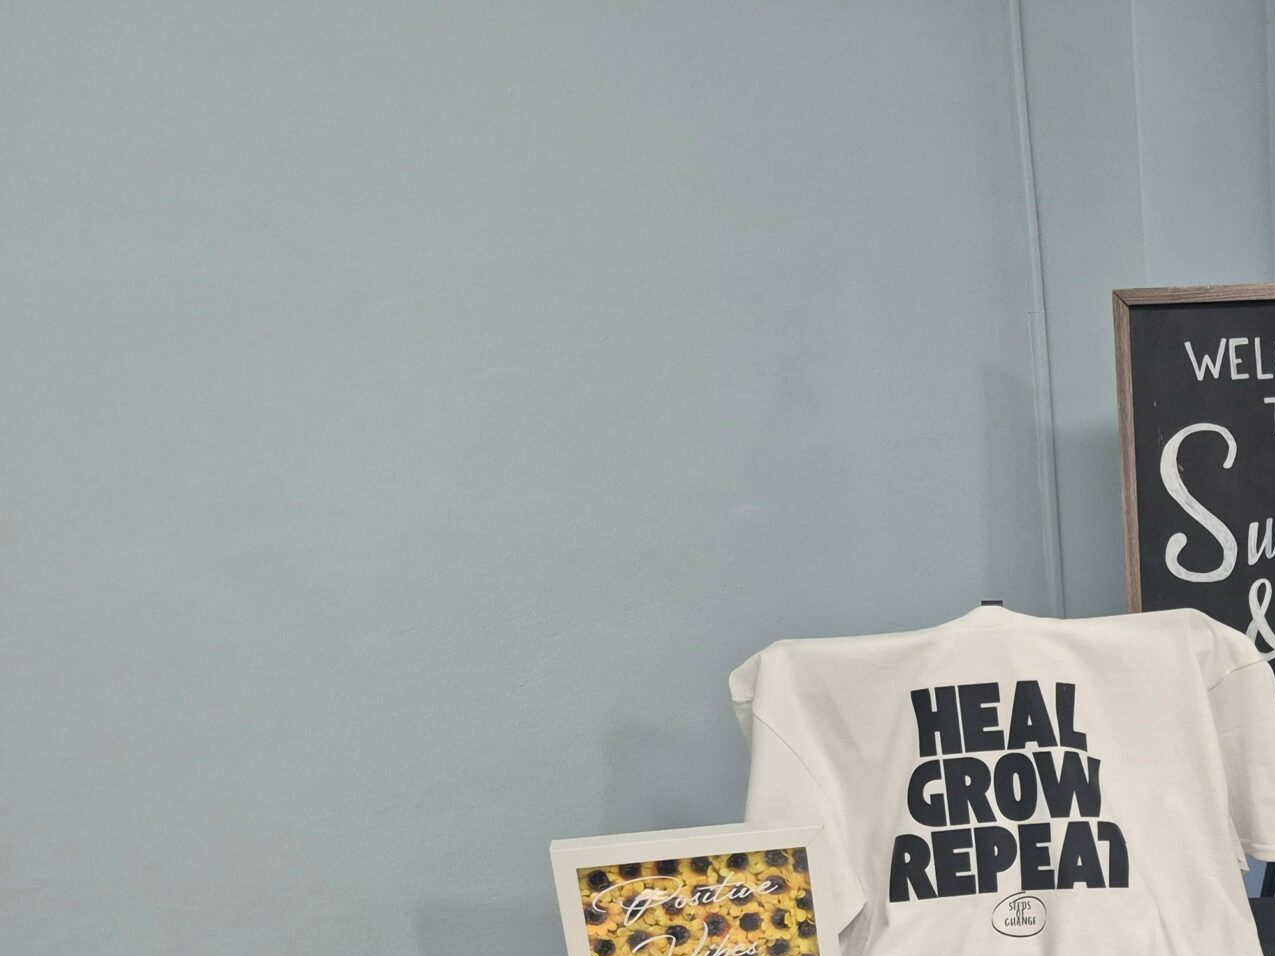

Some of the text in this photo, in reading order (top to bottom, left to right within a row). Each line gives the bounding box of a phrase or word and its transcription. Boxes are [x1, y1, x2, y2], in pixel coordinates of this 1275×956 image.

[910, 680, 1088, 758] HEAL
[907, 751, 1102, 827] GROW
[592, 871, 778, 926] Positive
[889, 821, 1130, 903] REPEAT
[1004, 916, 1036, 927] CHANGE
